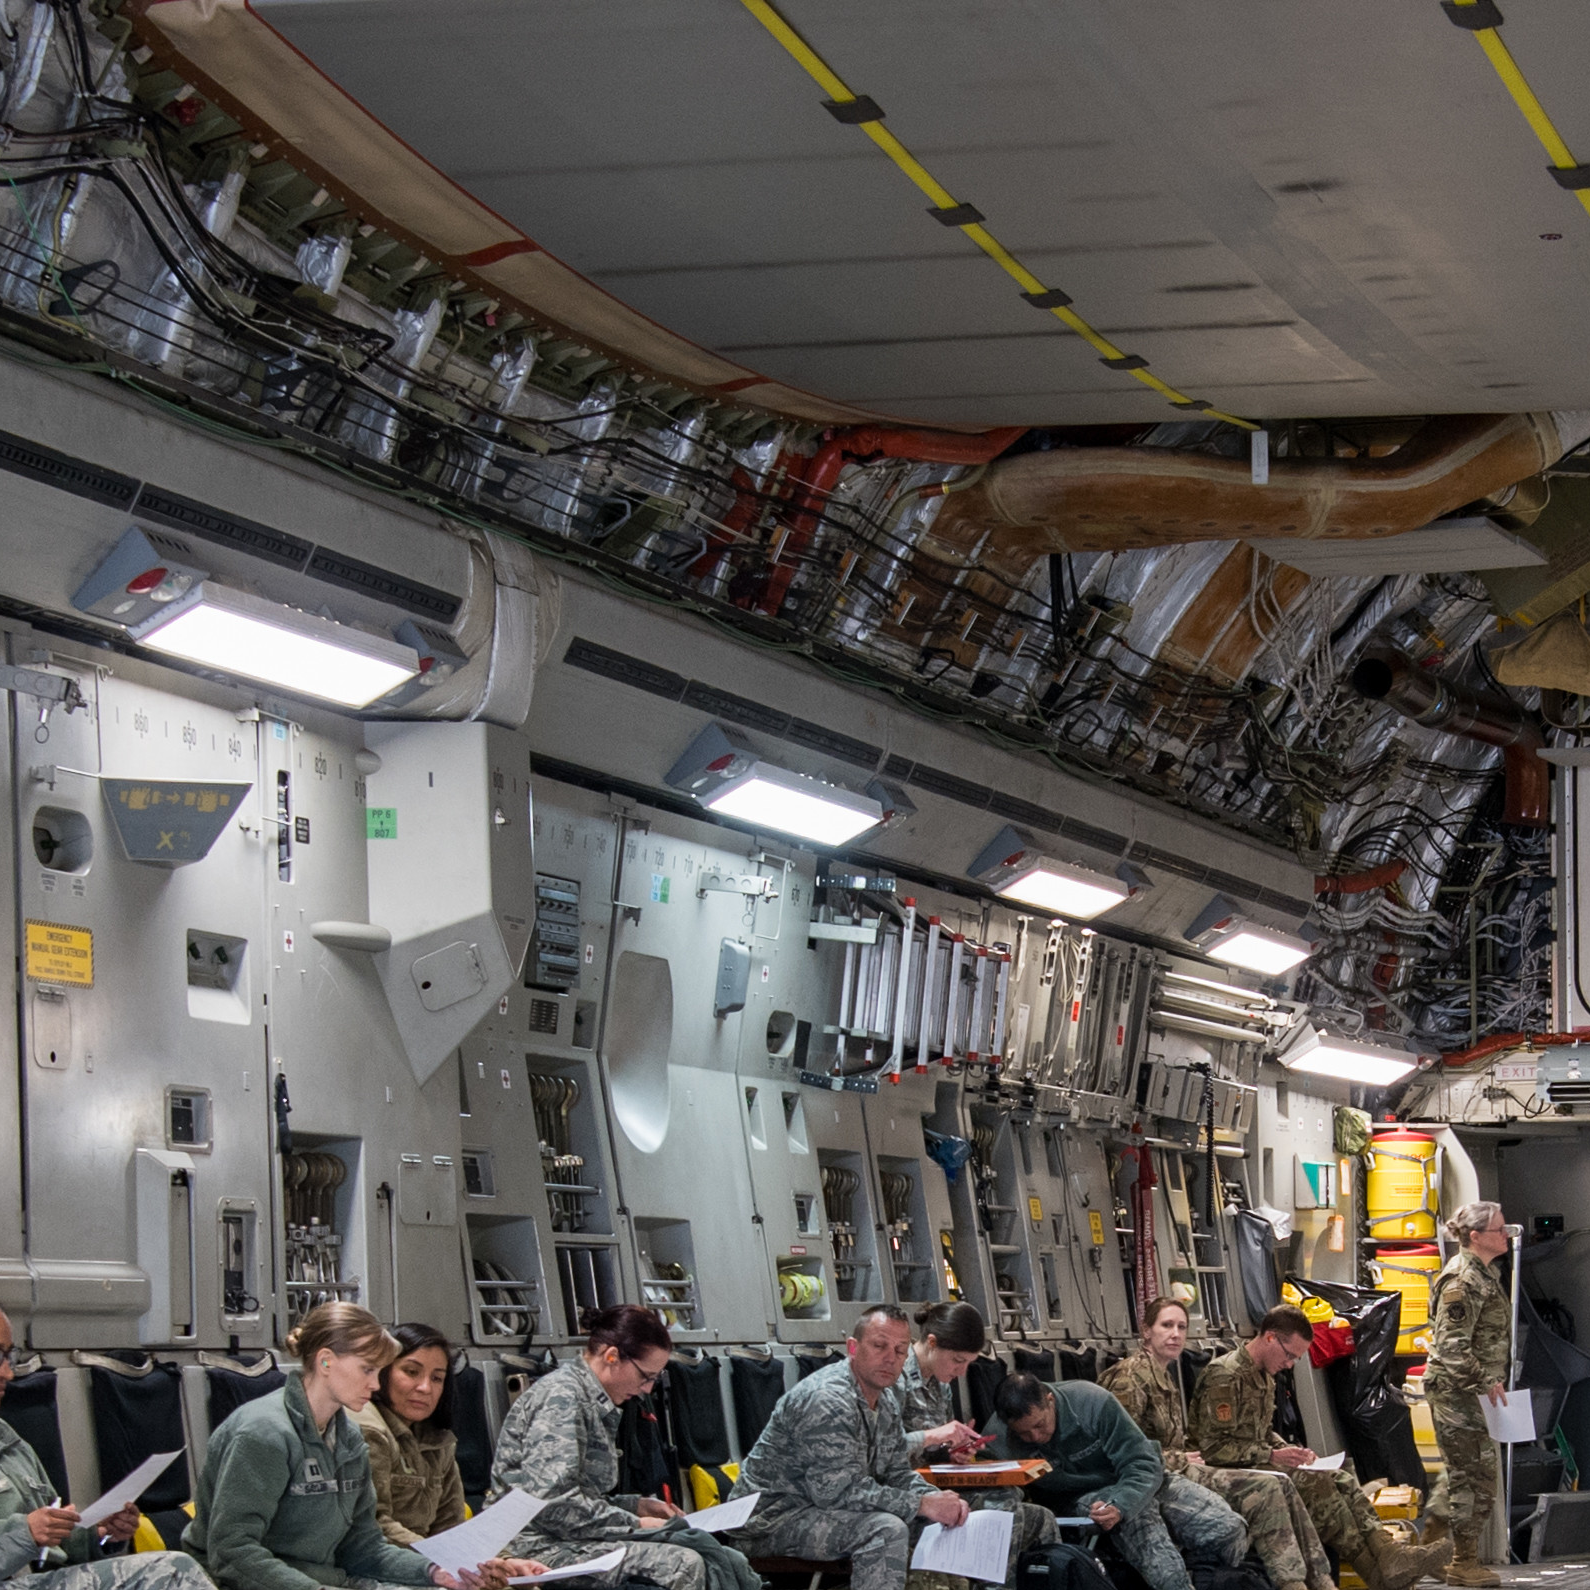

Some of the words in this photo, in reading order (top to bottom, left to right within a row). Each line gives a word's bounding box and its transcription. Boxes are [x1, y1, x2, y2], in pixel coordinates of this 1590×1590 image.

[134, 713, 149, 733] 860
[183, 725, 196, 746] 850
[228, 738, 242, 757] 840
[315, 756, 327, 776] 820
[372, 809, 383, 818] PP
[375, 828, 389, 838] 807
[46, 931, 71, 943] EMERGENCY
[32, 942, 49, 953] MANUAL
[51, 945, 62, 954] GEAR
[64, 947, 88, 958] EXTENSION
[1501, 1066, 1535, 1078] EXIT
[936, 1476, 998, 1485] HOT-N-READY
